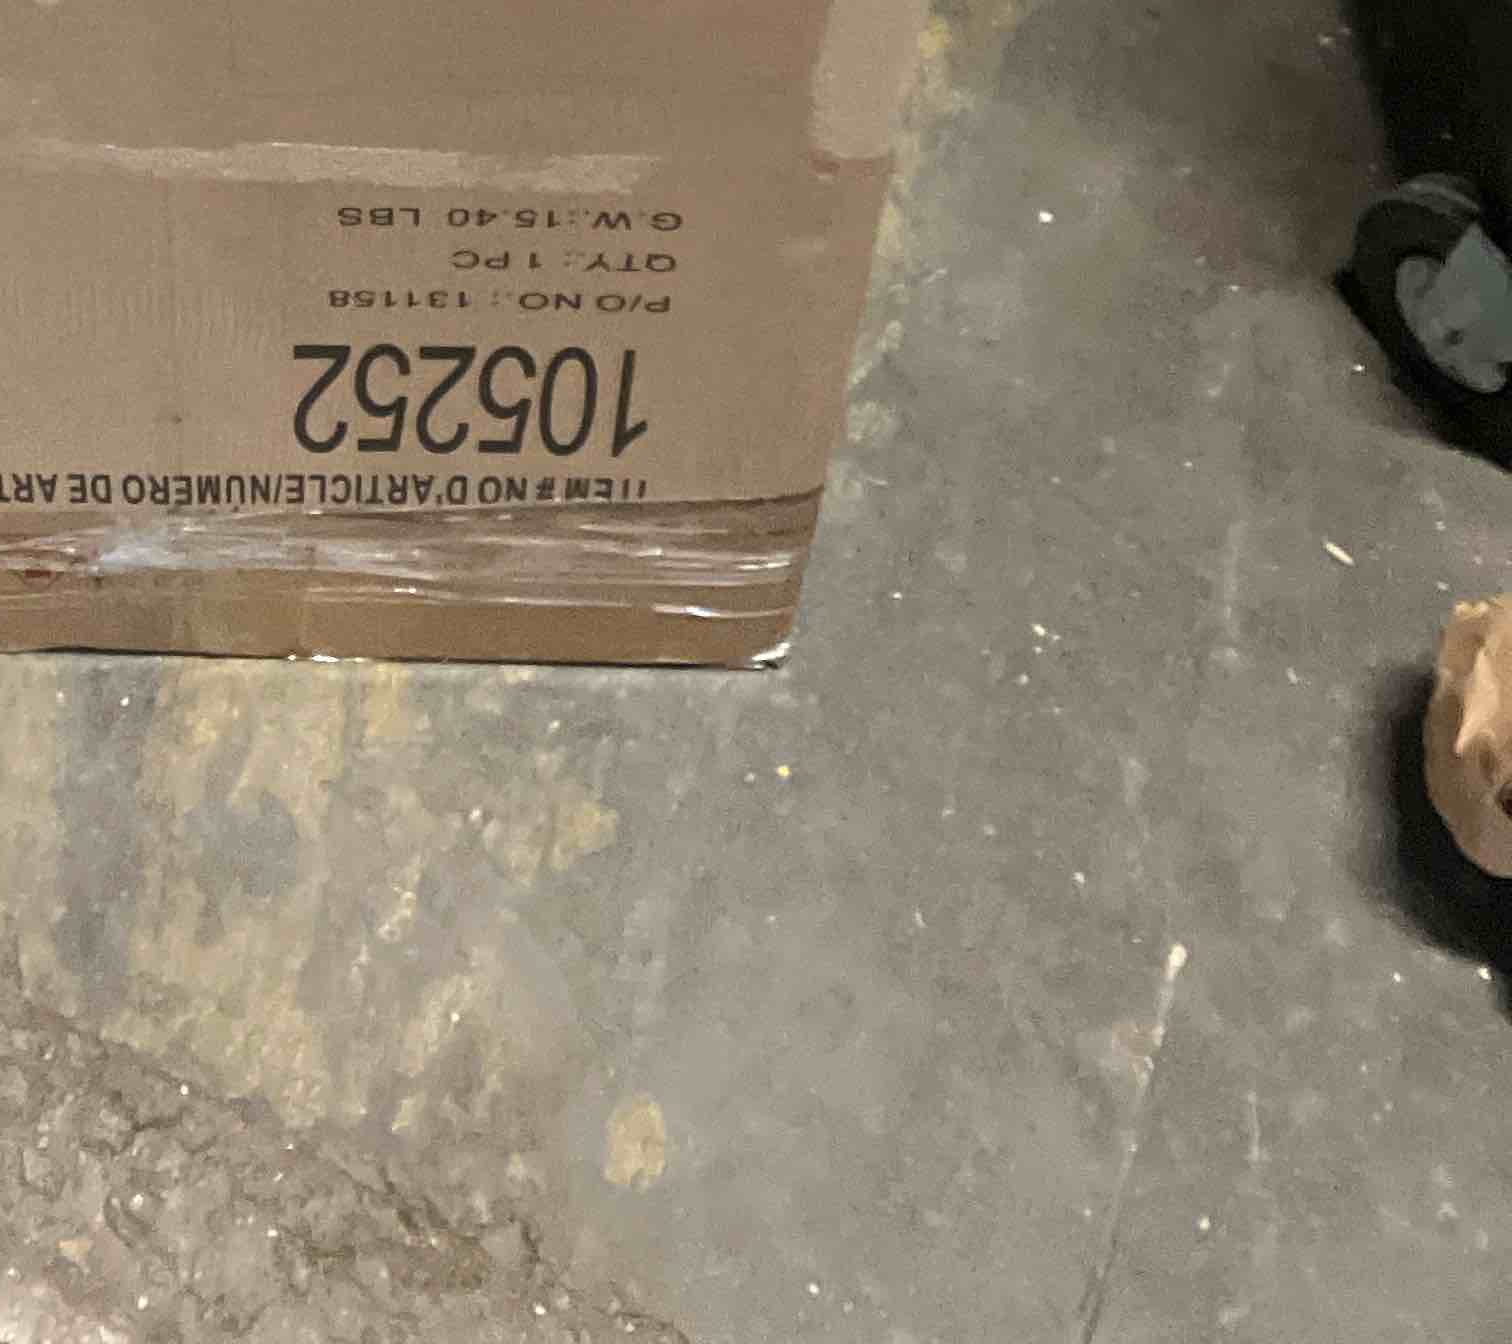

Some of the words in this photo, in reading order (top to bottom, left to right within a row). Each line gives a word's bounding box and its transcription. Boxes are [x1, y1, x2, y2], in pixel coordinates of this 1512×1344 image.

[337, 206, 422, 227] LBS
[451, 249, 511, 270] PC
[329, 289, 473, 309] 131158
[594, 292, 672, 313] P/O
[292, 343, 649, 458] 105252
[68, 472, 113, 505] DE
[477, 476, 528, 502] NO
